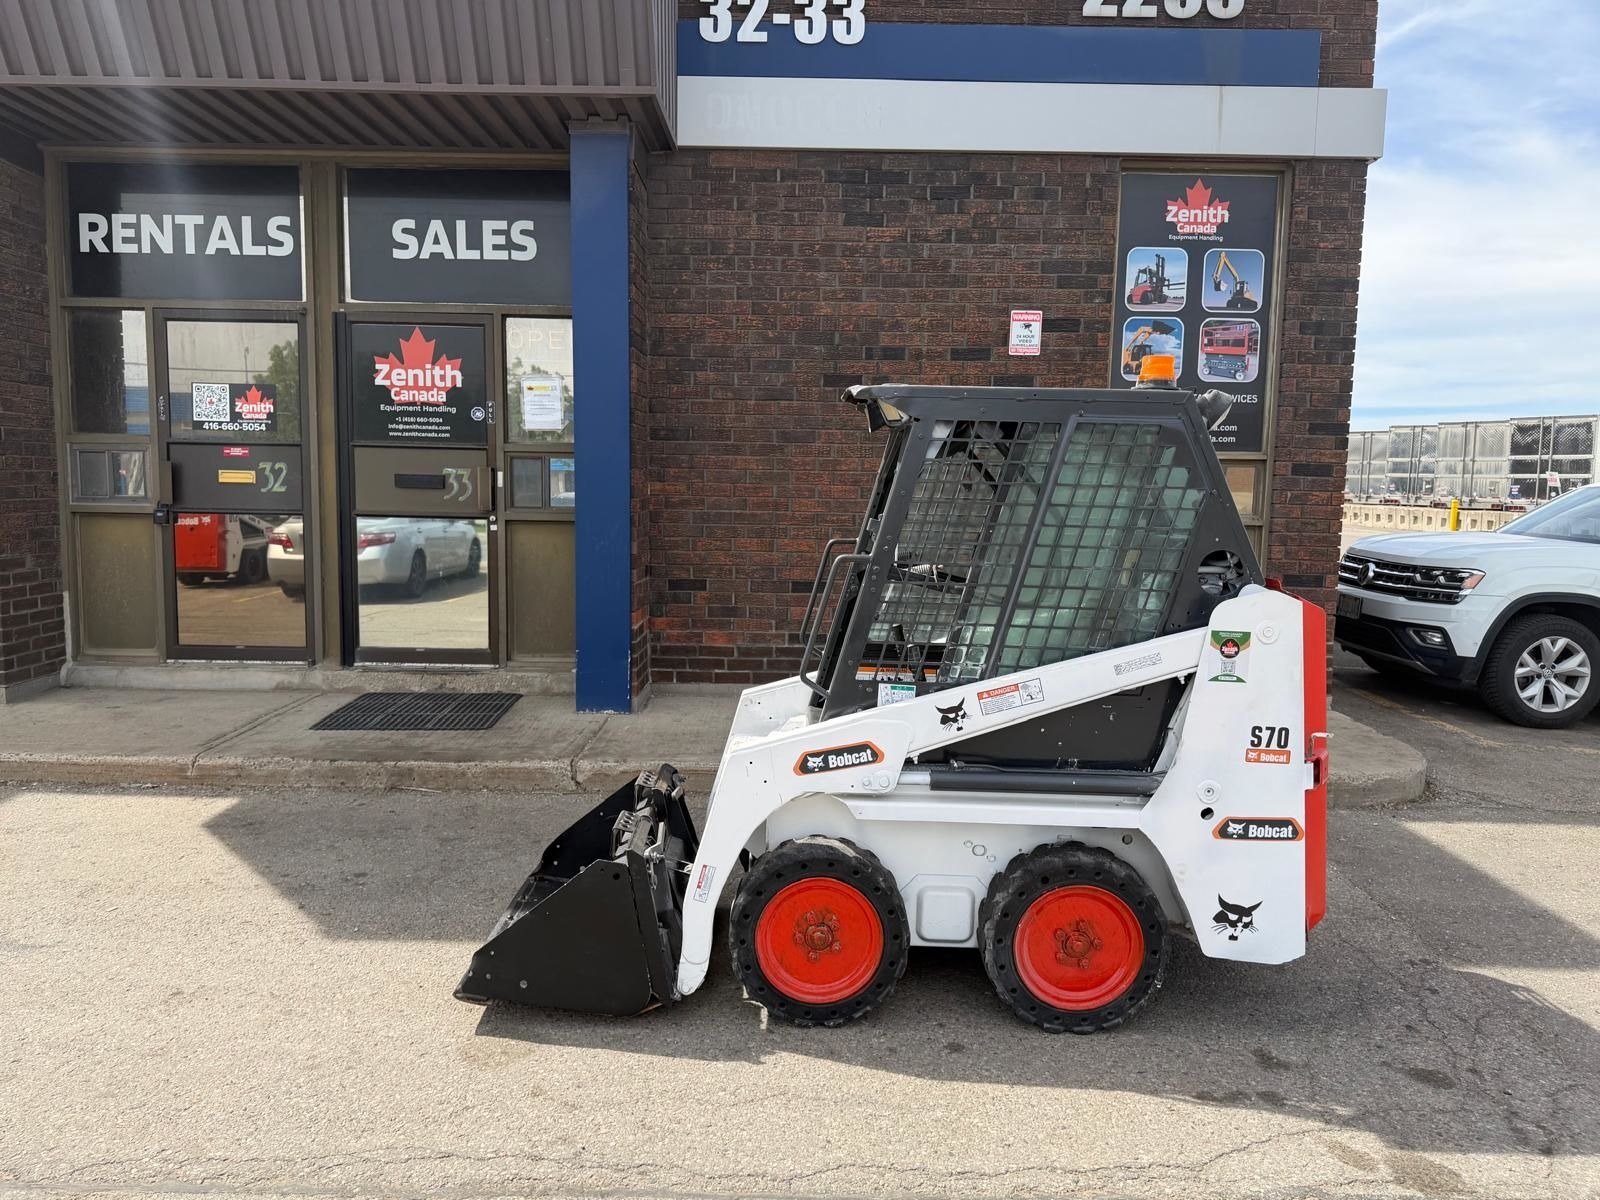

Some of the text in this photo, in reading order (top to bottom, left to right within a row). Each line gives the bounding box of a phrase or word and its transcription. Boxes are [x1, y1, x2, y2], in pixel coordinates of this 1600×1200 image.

[699, 0, 866, 45] 32-33
[1165, 205, 1229, 223] Zenith
[78, 213, 294, 257] RENTALS
[1177, 223, 1217, 233] Canada
[391, 218, 537, 262] SALES
[374, 364, 463, 388] Zenith
[390, 387, 447, 402] Canada
[1232, 394, 1258, 404] VICES
[234, 402, 274, 413] Zenith
[379, 404, 457, 414] Equipment Handling
[241, 412, 267, 420] Canada
[202, 422, 267, 432] 416-660-5054
[258, 461, 289, 493] 32
[441, 467, 473, 502] 33
[989, 684, 1016, 697] DANGER
[1249, 725, 1290, 749] S70
[827, 748, 874, 769] Bobcat
[1259, 751, 1288, 763] Bobcat
[1248, 823, 1294, 839] Bobcat
